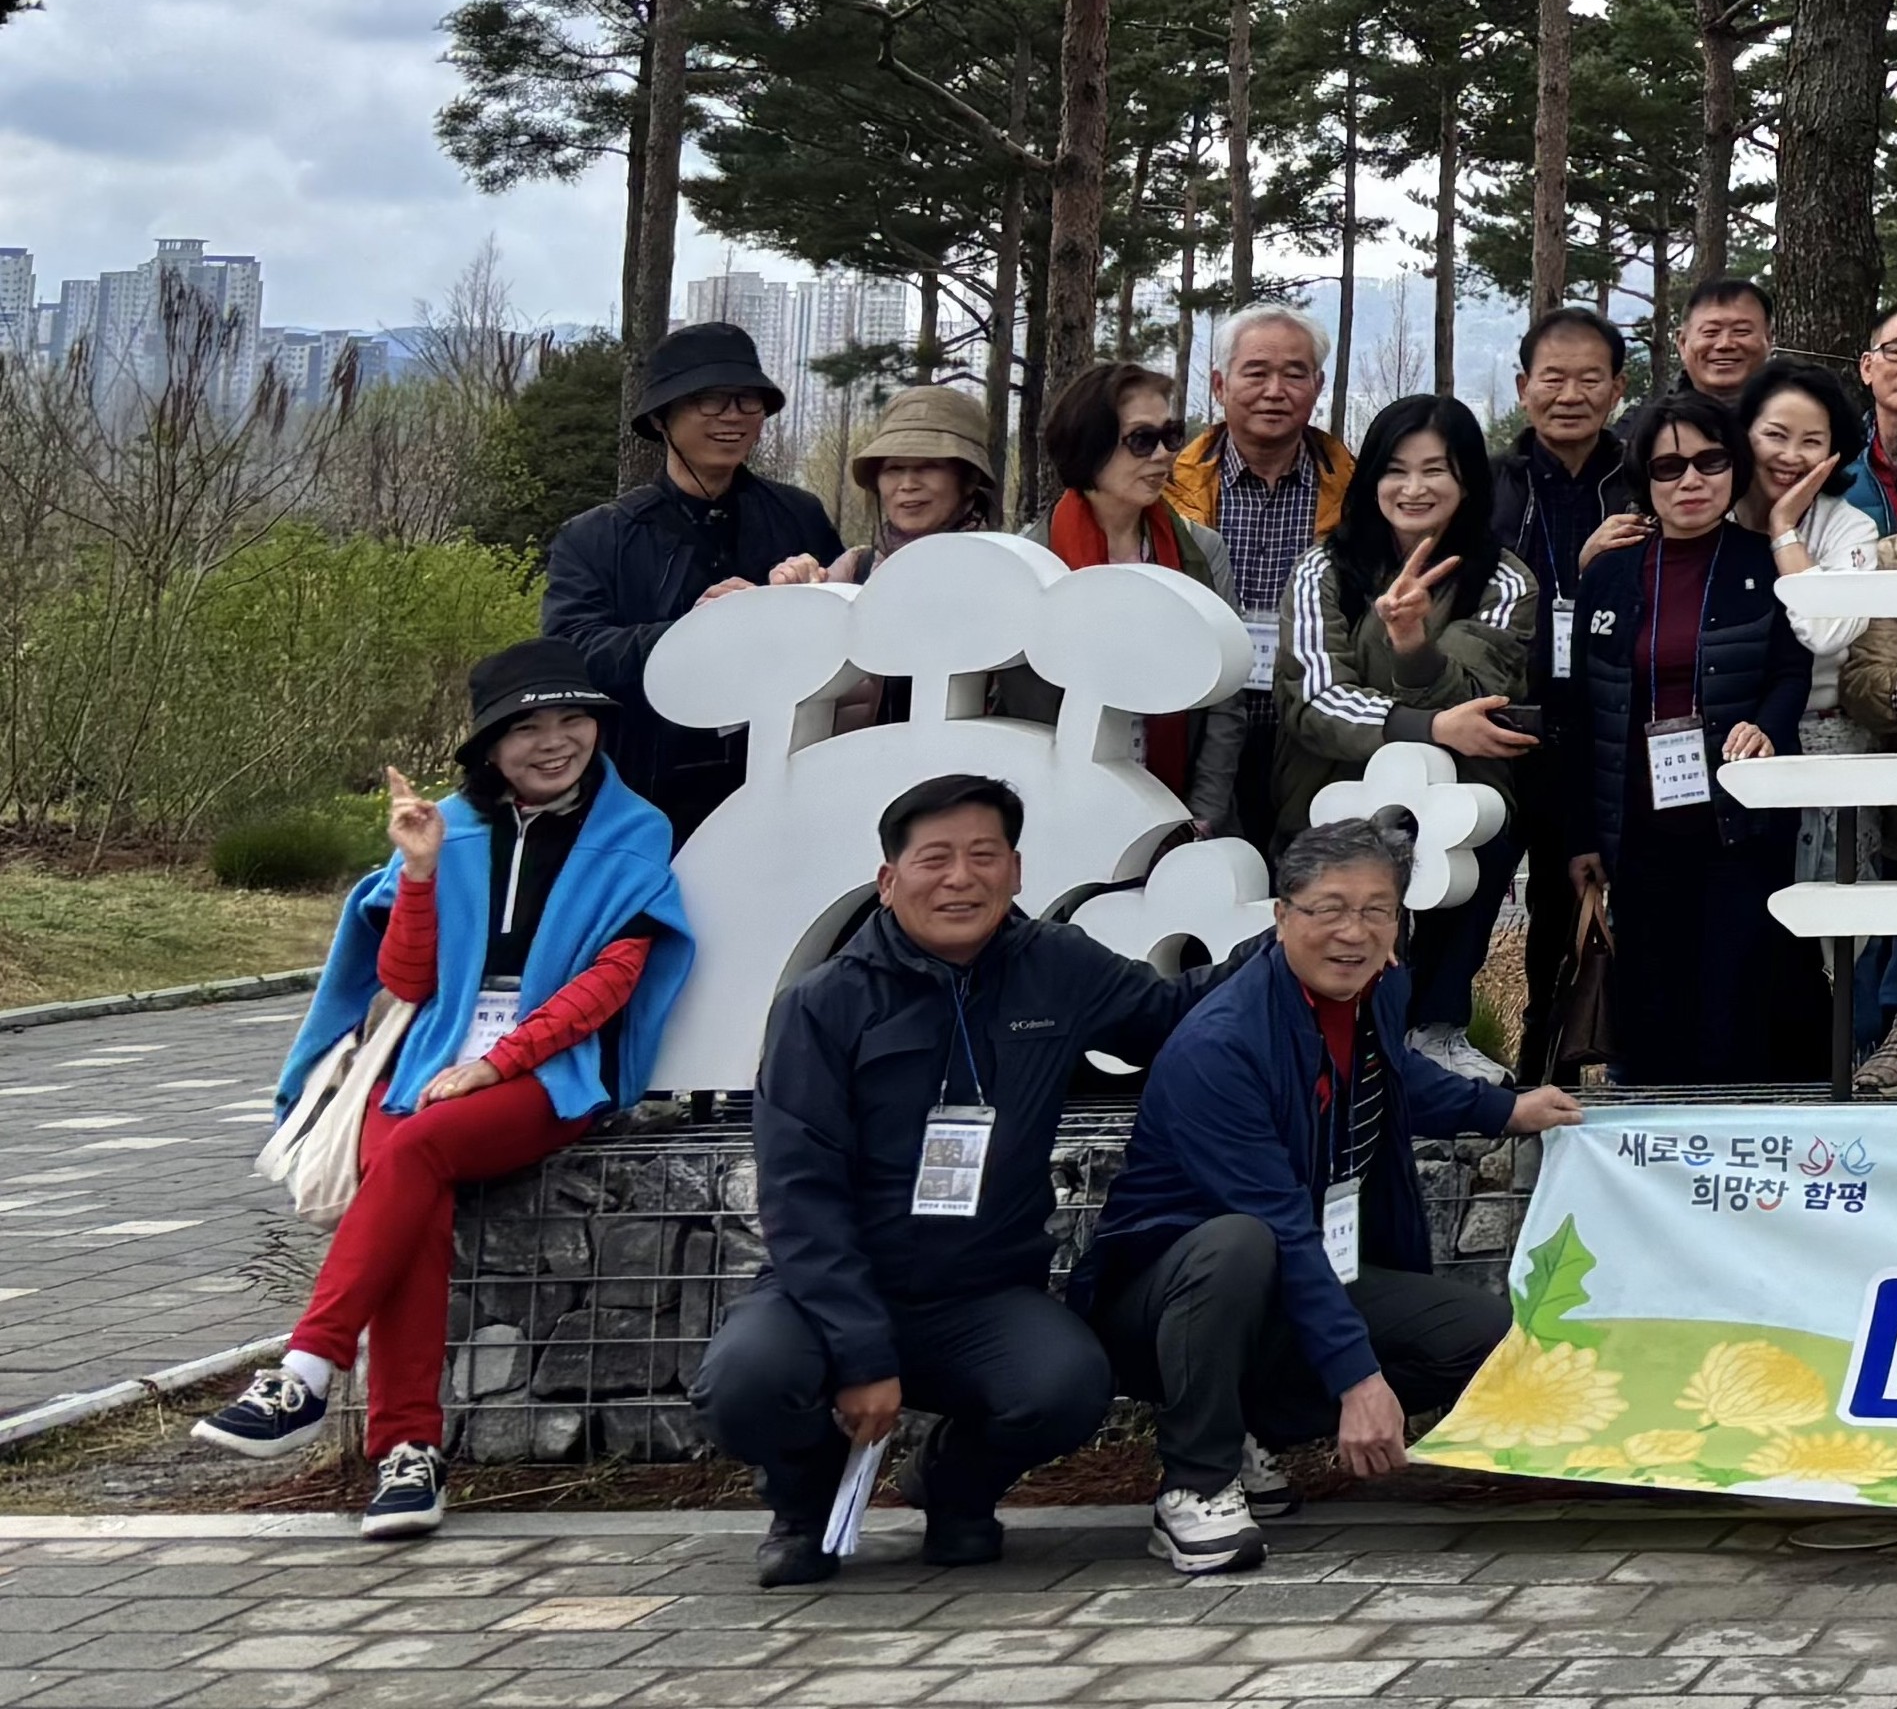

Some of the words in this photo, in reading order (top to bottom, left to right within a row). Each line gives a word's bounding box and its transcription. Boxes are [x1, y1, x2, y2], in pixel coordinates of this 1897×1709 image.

[1590, 609, 1617, 635] 62
[1617, 1133, 1715, 1167] 새로운
[1726, 1136, 1793, 1173] 도약
[1691, 1174, 1789, 1212] 희망찬
[1803, 1181, 1868, 1213] 함평
